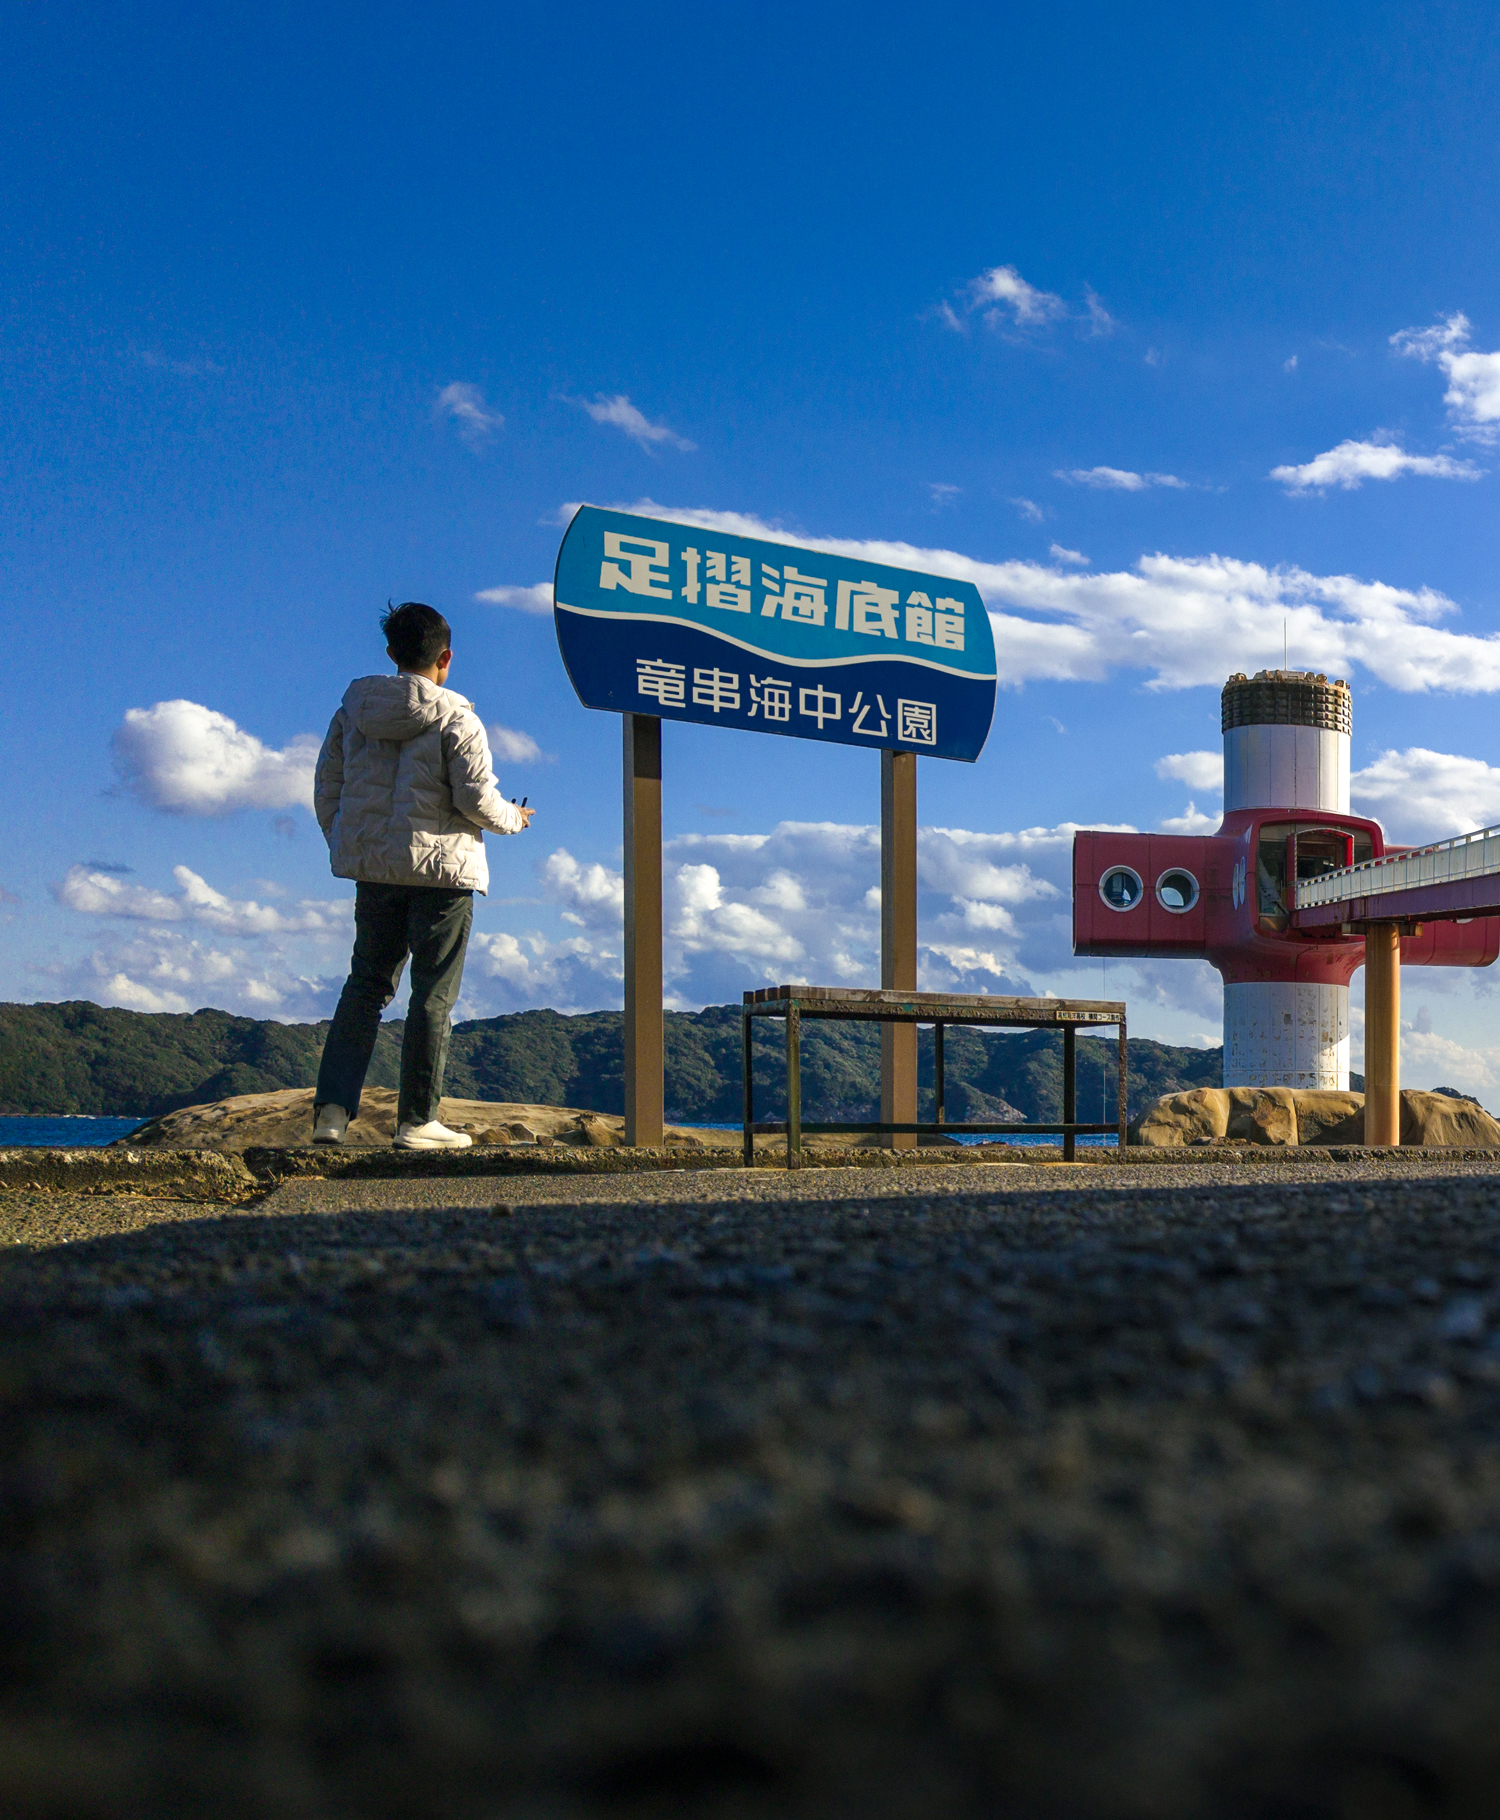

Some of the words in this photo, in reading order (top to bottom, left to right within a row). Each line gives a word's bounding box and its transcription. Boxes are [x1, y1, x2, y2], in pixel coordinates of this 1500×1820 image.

[600, 531, 965, 652] 足摺海底館
[636, 658, 937, 746] 竜串海中公園
